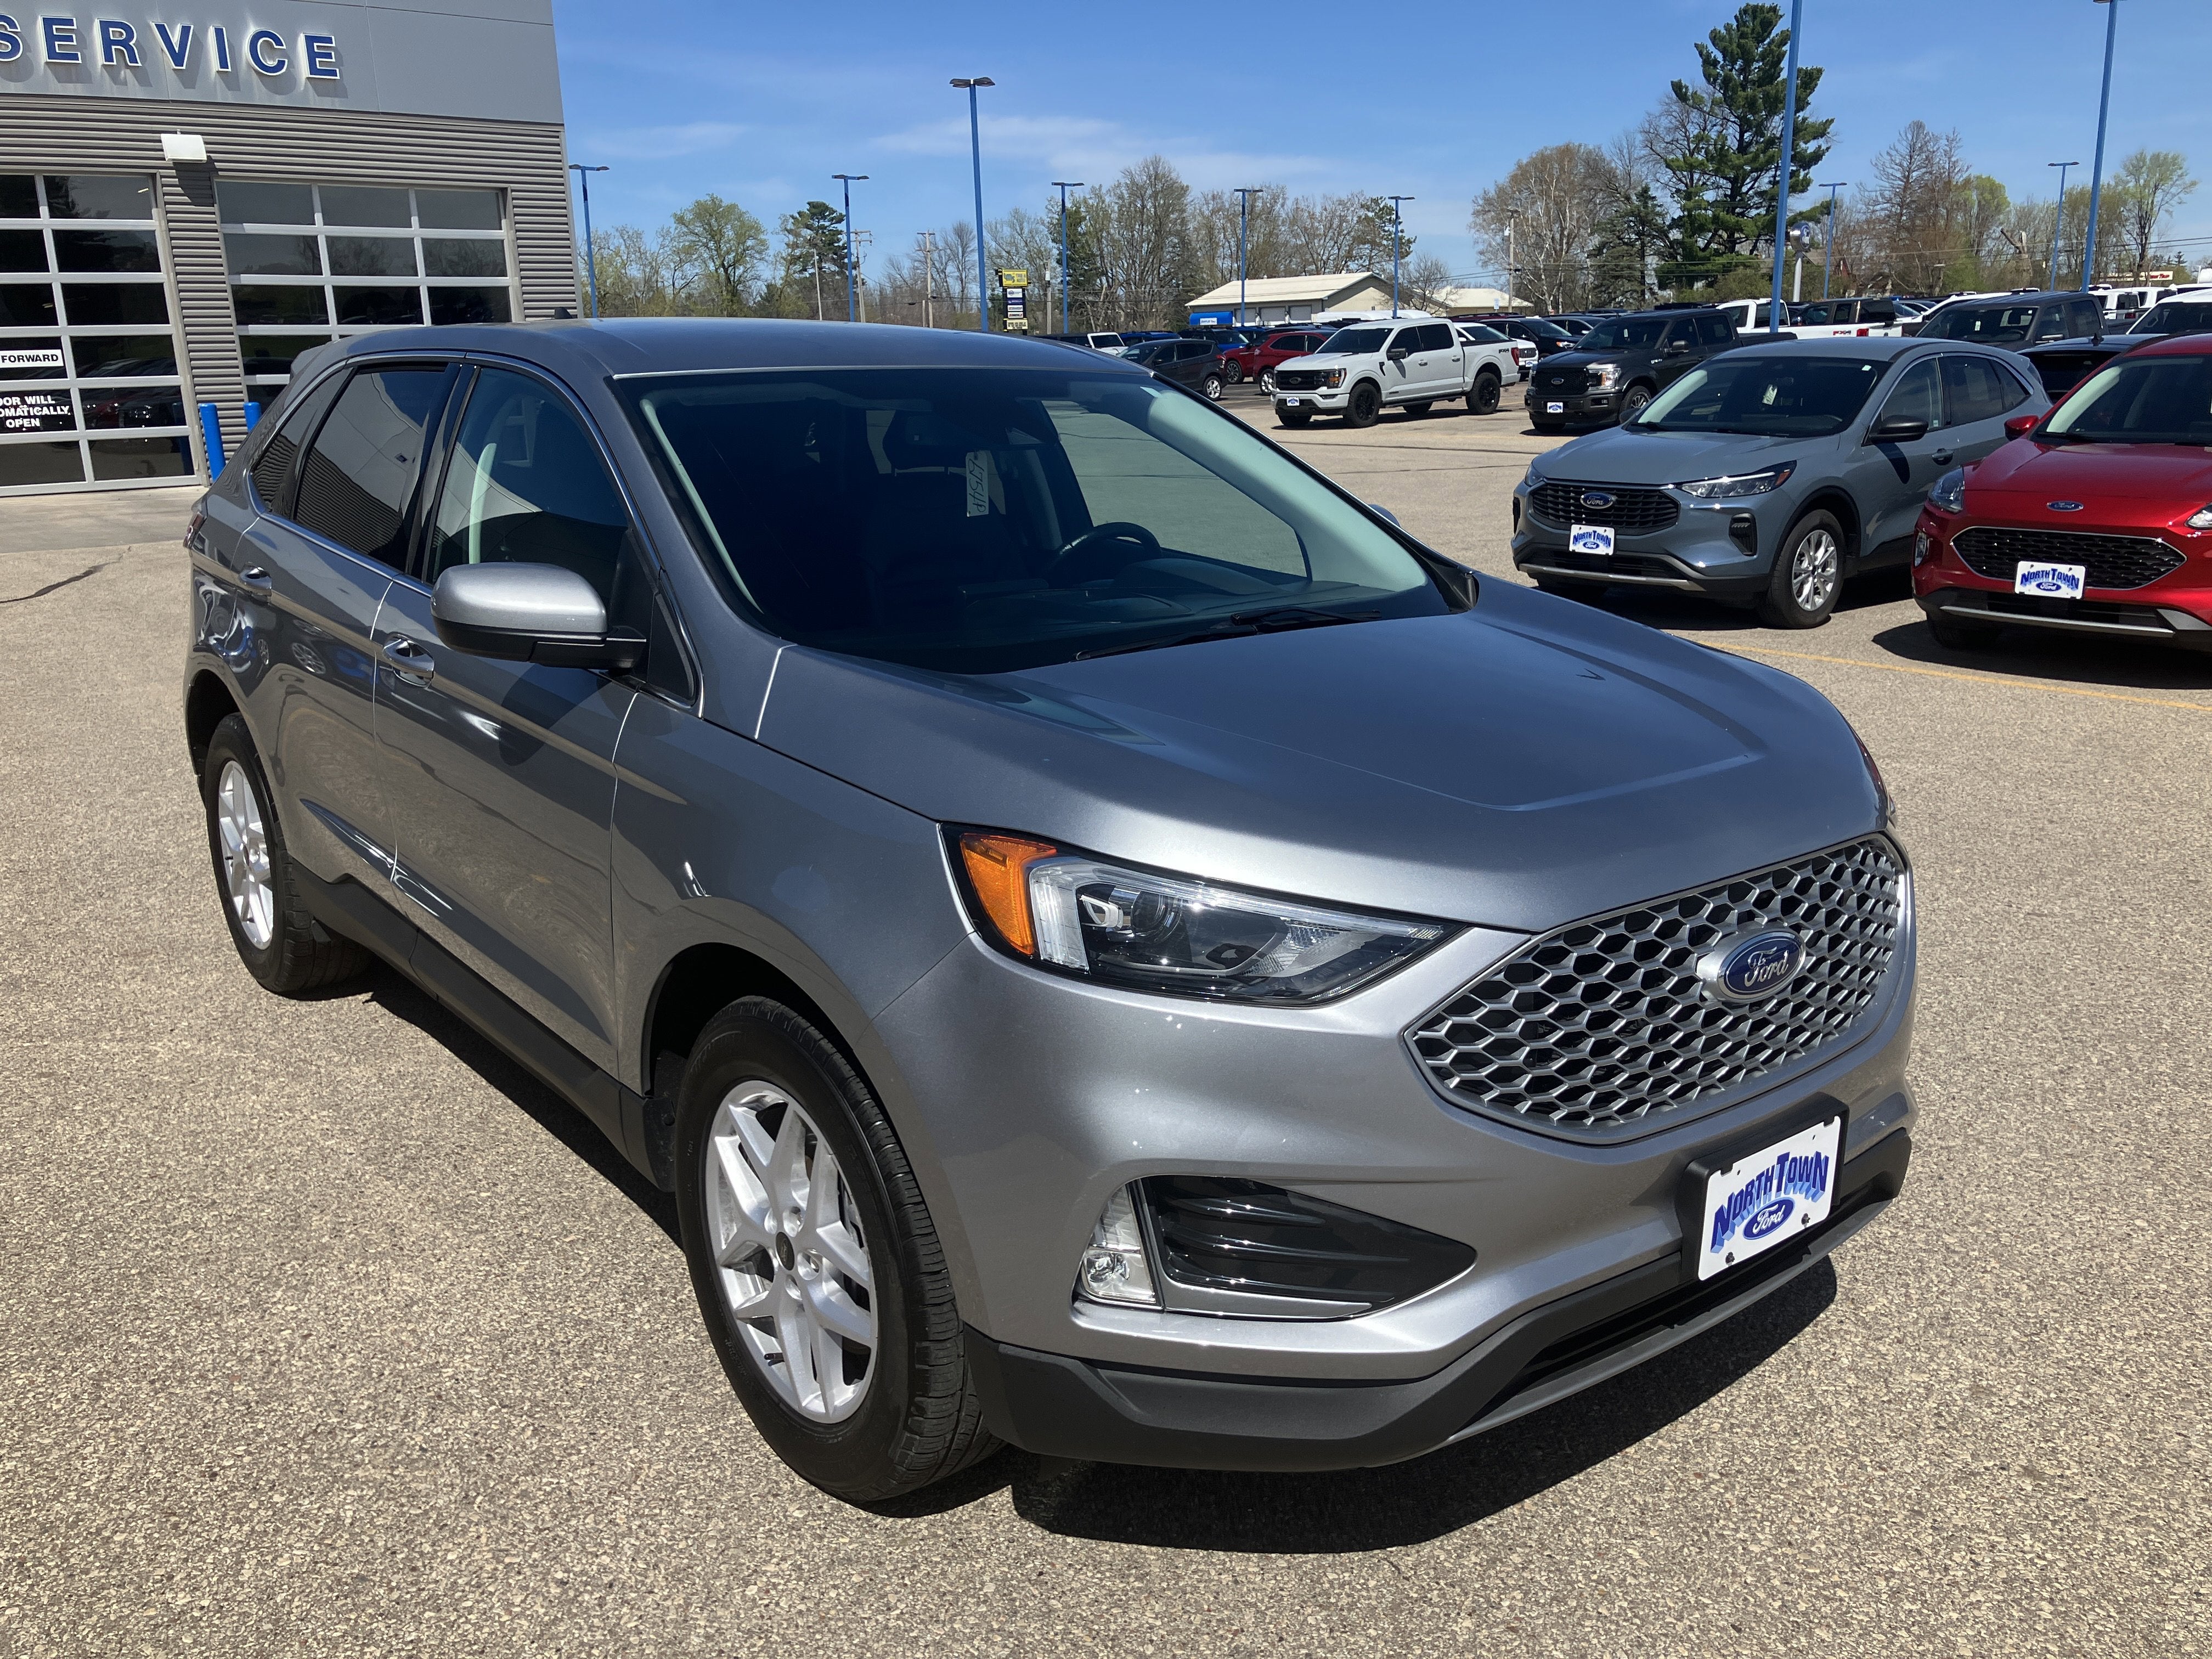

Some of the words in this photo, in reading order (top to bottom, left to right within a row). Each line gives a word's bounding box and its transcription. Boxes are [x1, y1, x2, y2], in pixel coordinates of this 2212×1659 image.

[0, 13, 340, 80] SERVICE
[2, 354, 58, 363] FORWARD
[25, 396, 55, 405] WILL
[5, 418, 40, 428] OPEN
[968, 458, 986, 513] 6754P
[1572, 532, 1592, 546] NORTH
[1593, 530, 1611, 548] TOWN
[2020, 570, 2050, 587] NORTH
[2051, 568, 2079, 591] TOWN
[2040, 582, 2057, 590] Ford
[1745, 946, 1788, 987] Ford
[1710, 1164, 1776, 1254] NORTH
[1775, 1151, 1829, 1203] TOWN
[1752, 1203, 1786, 1234] Ford
